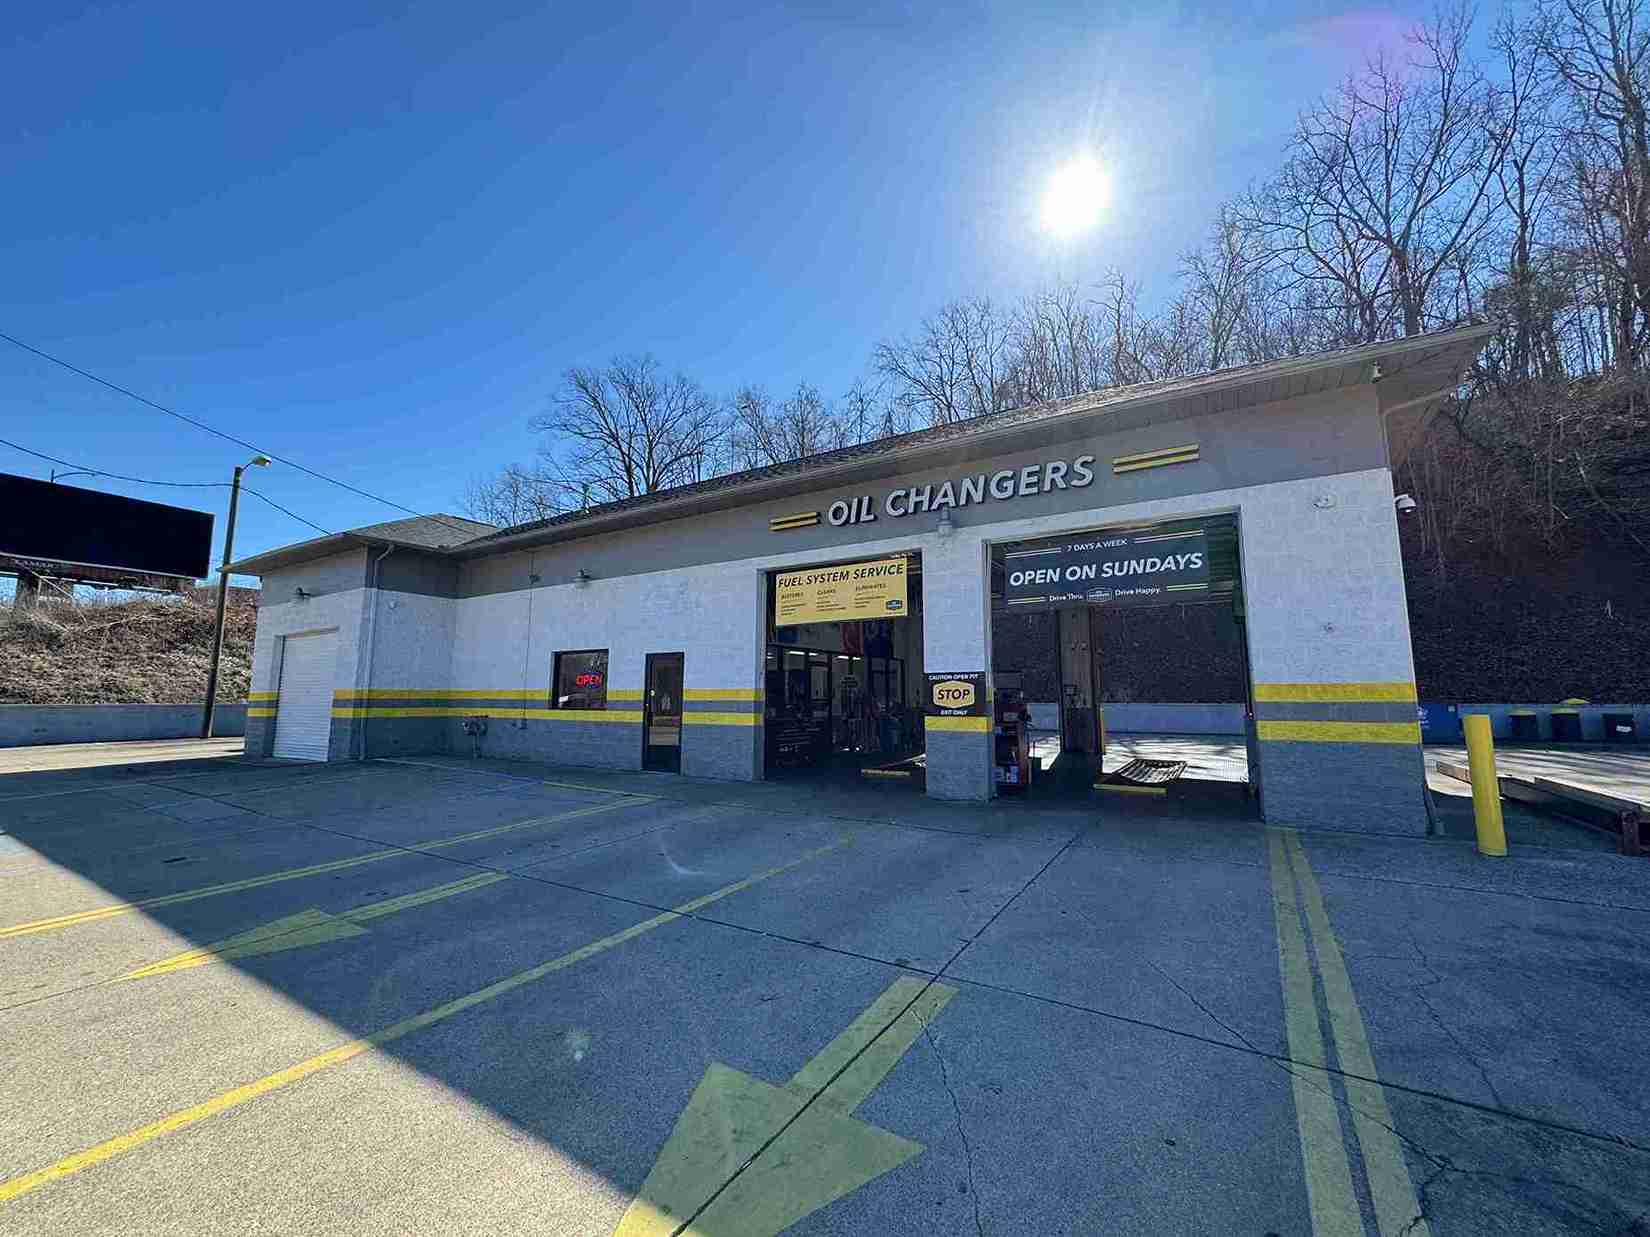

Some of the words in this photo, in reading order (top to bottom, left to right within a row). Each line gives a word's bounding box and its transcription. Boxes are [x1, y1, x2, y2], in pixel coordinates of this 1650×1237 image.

[828, 496, 876, 527] OIL
[885, 454, 1096, 518] CHANGERS
[1073, 543, 1094, 552] DAYS
[1103, 538, 1128, 548] WEEK
[777, 576, 804, 589] FUEL
[806, 571, 849, 585] SYSTEM
[853, 564, 904, 580] SERVICE
[1008, 567, 1061, 587] OPEN
[1065, 563, 1097, 581] ON
[1101, 552, 1204, 578] SUNDAYS
[1114, 589, 1134, 597] Drive
[937, 688, 970, 700] STOP
